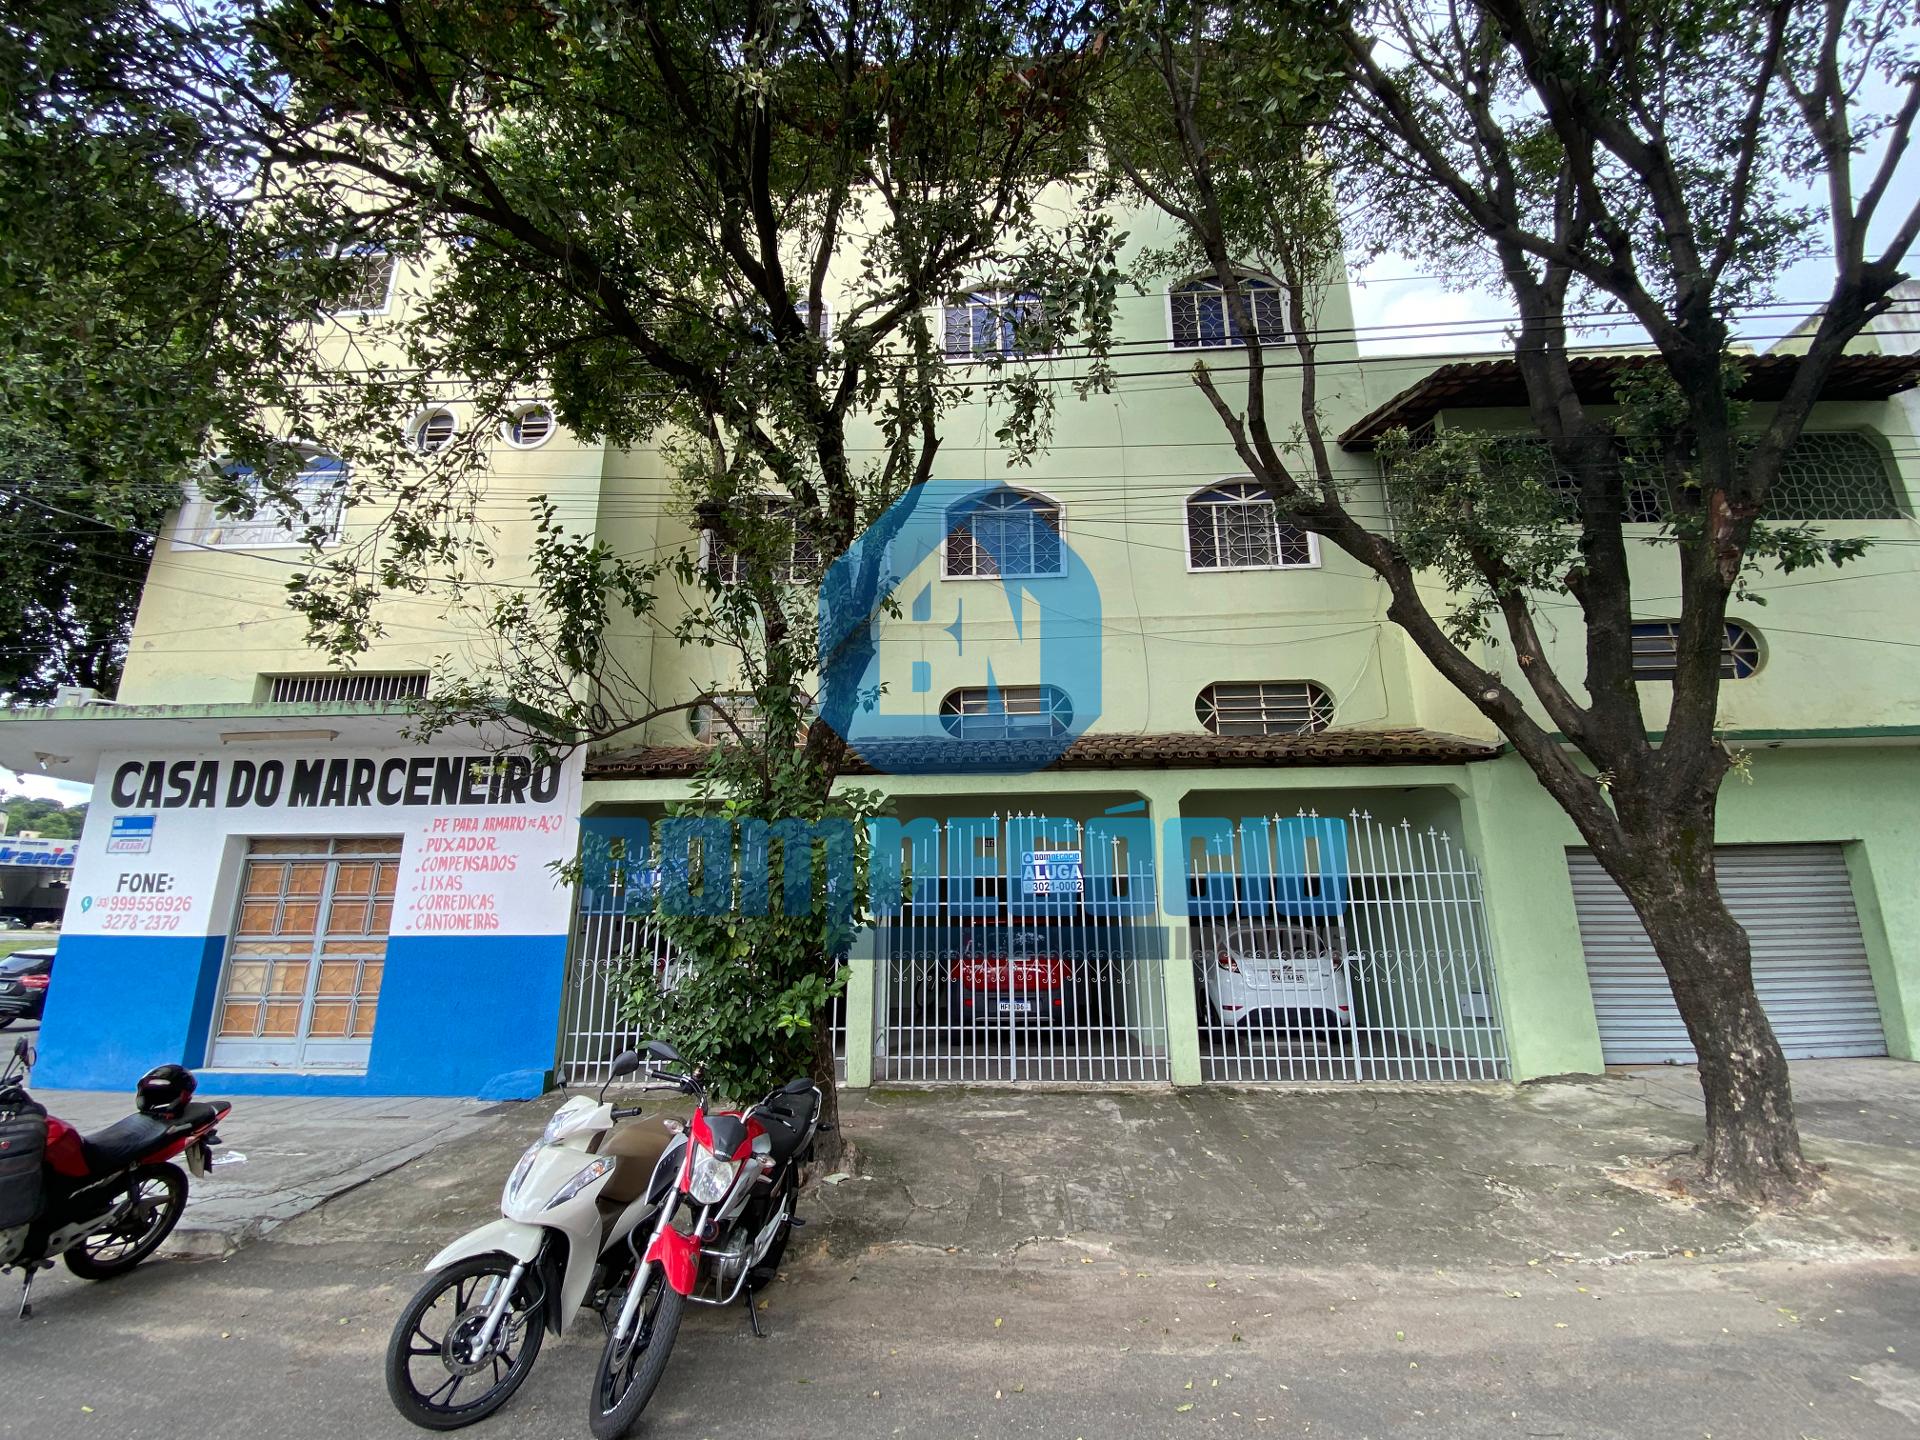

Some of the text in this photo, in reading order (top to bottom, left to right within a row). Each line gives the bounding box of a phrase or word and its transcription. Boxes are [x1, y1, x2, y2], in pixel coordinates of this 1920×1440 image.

[111, 755, 562, 808] CASA DO MARCENEIRO
[452, 817, 479, 832] PARA
[483, 816, 527, 832] ARMARIO
[426, 836, 501, 853] PUXADOR
[421, 854, 519, 872] COMPENSADOS
[1023, 864, 1083, 880] ALUGA
[117, 873, 175, 893] FONE:
[421, 875, 463, 891] LIXAS
[1033, 882, 1083, 892] 3021-0002
[110, 895, 193, 912] 999556926
[102, 914, 180, 930] 3278-2370
[415, 913, 499, 930] CANTONEIRAS
